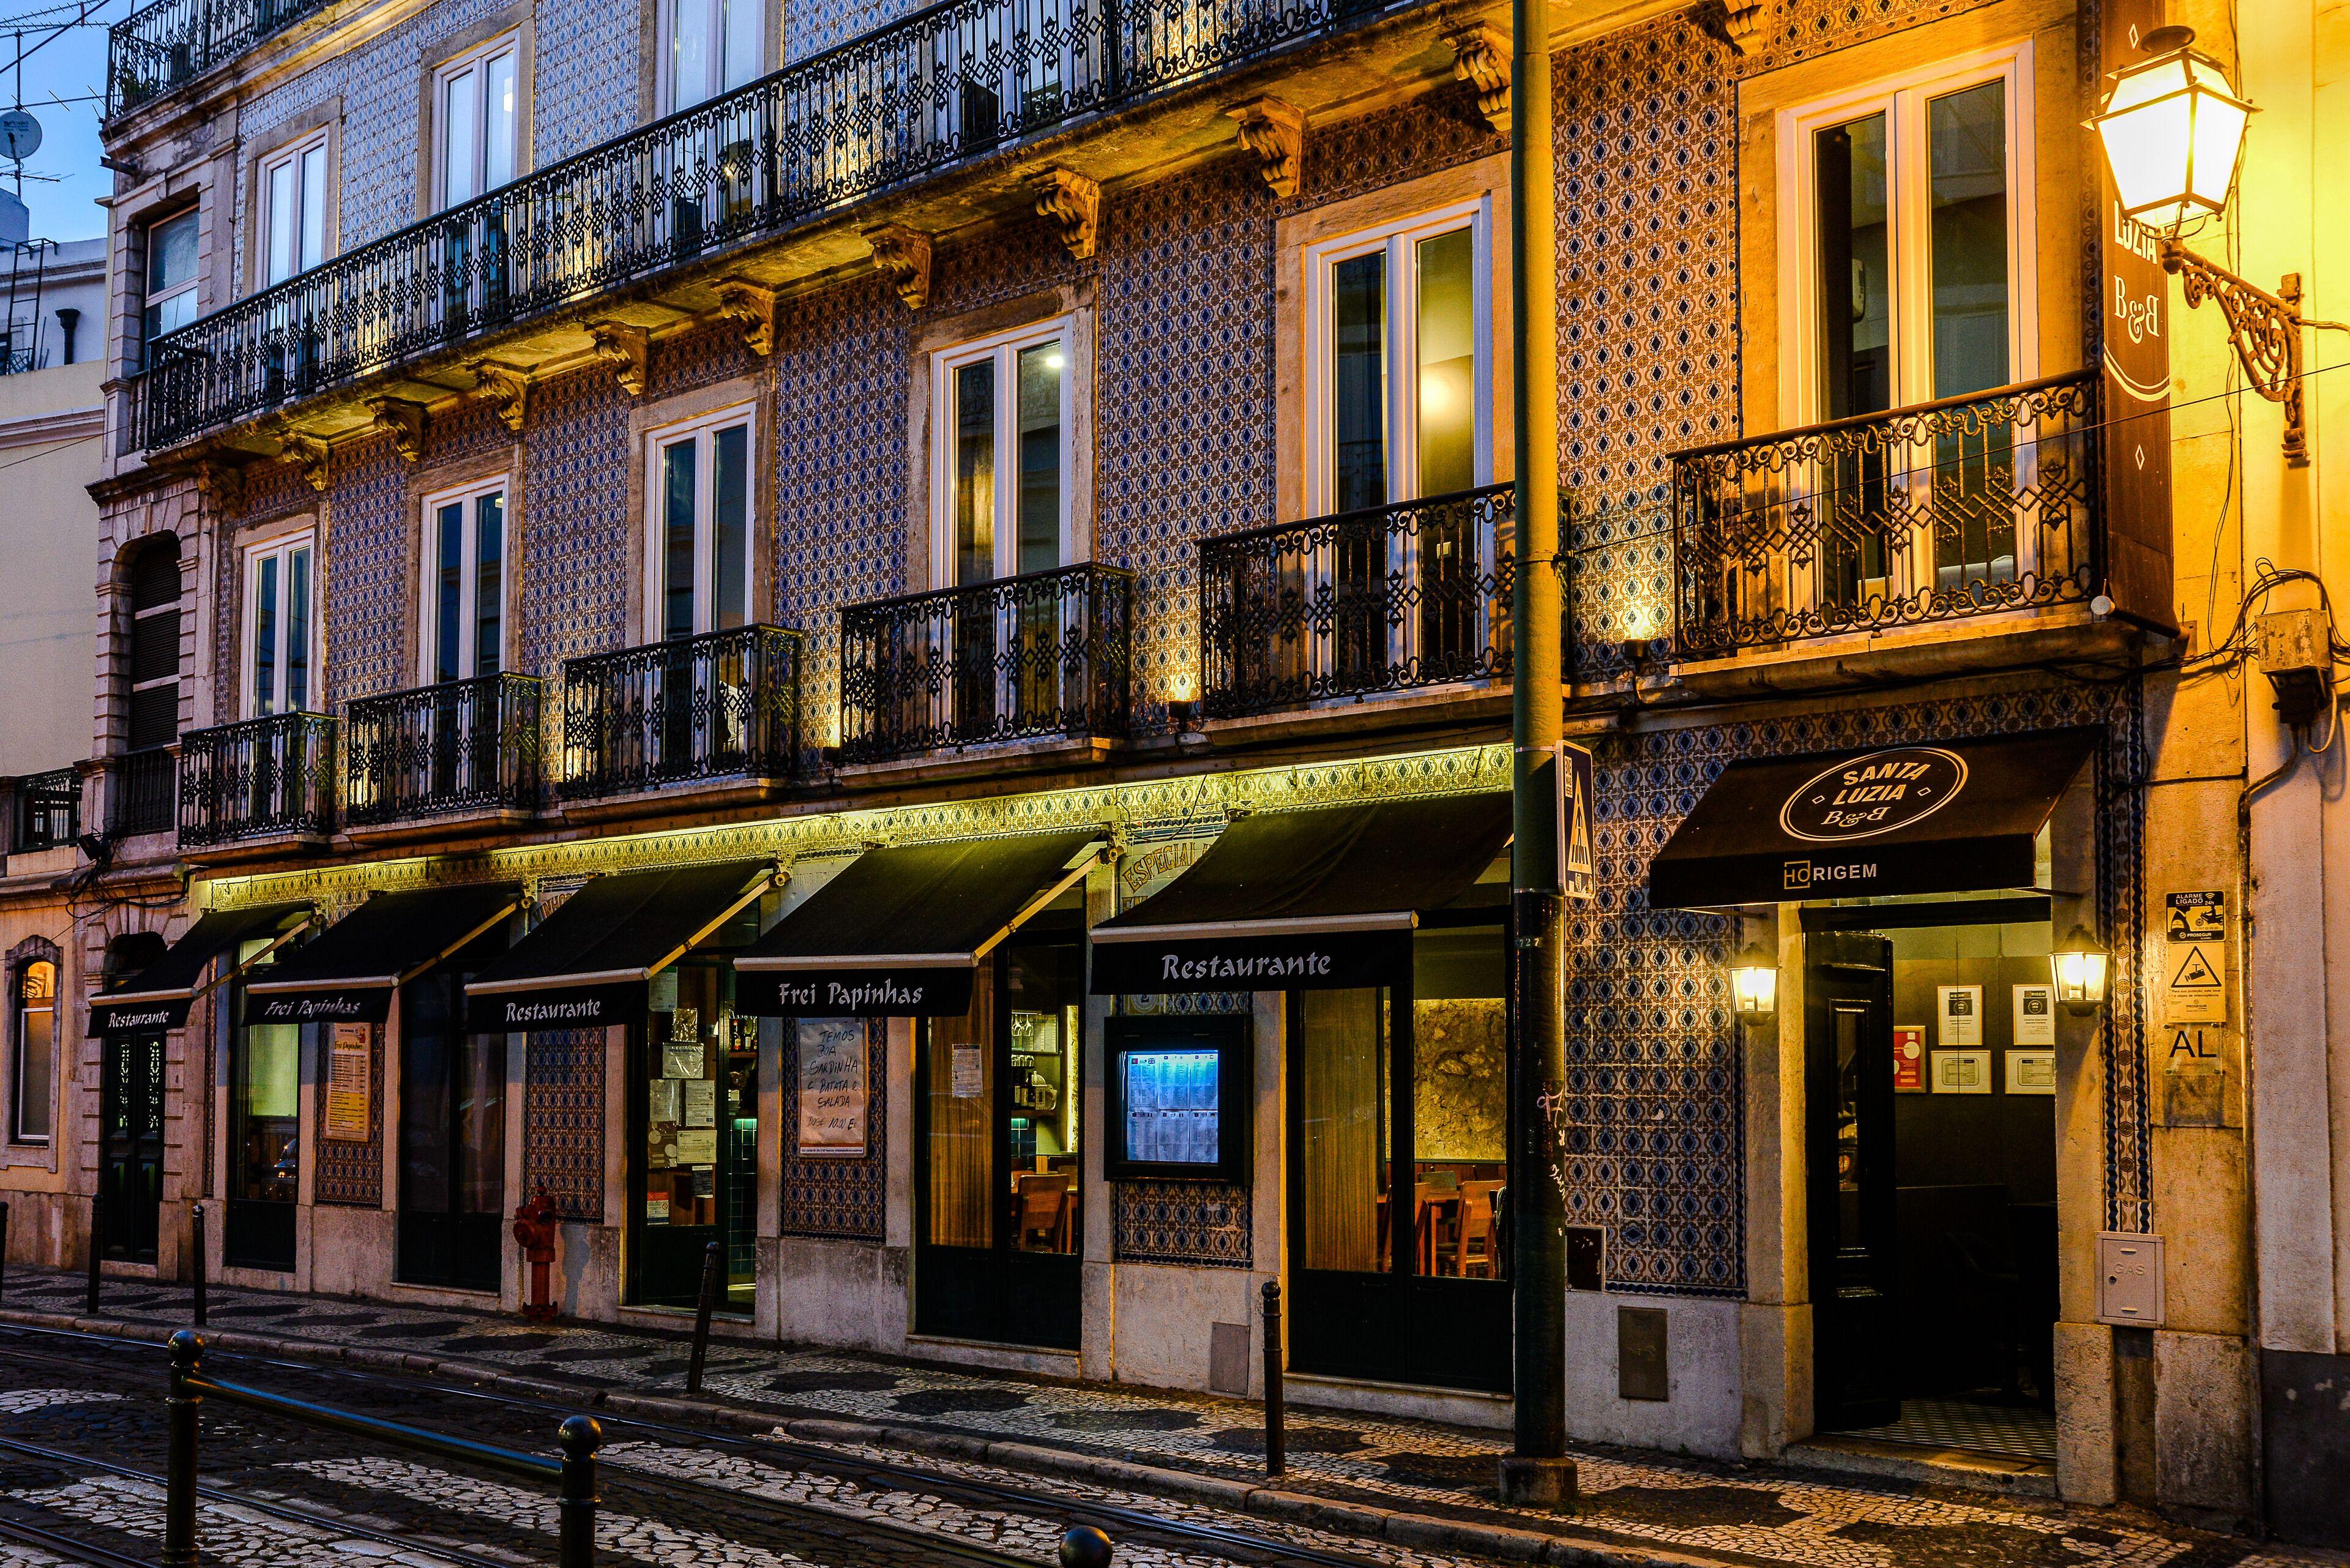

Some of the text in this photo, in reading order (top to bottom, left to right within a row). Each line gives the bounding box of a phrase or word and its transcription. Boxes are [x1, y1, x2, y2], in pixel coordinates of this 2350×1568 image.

[2114, 200, 2157, 264] LUZIA
[2114, 275, 2160, 344] B&B
[1843, 762, 1931, 785] SANTA
[1832, 784, 1907, 805] LUZIA
[1821, 807, 1891, 827] B&B
[1162, 952, 1331, 980] Restaurante
[778, 979, 923, 1010] Frei Papinhas
[264, 997, 360, 1018] Frei Papinhas
[506, 999, 601, 1022] Restaurante
[108, 1010, 170, 1028] Restaurante
[819, 1029, 855, 1043] TEMOS
[2169, 1031, 2217, 1058] AL
[819, 1078, 848, 1094] BATATA
[818, 1096, 850, 1108] SALADA
